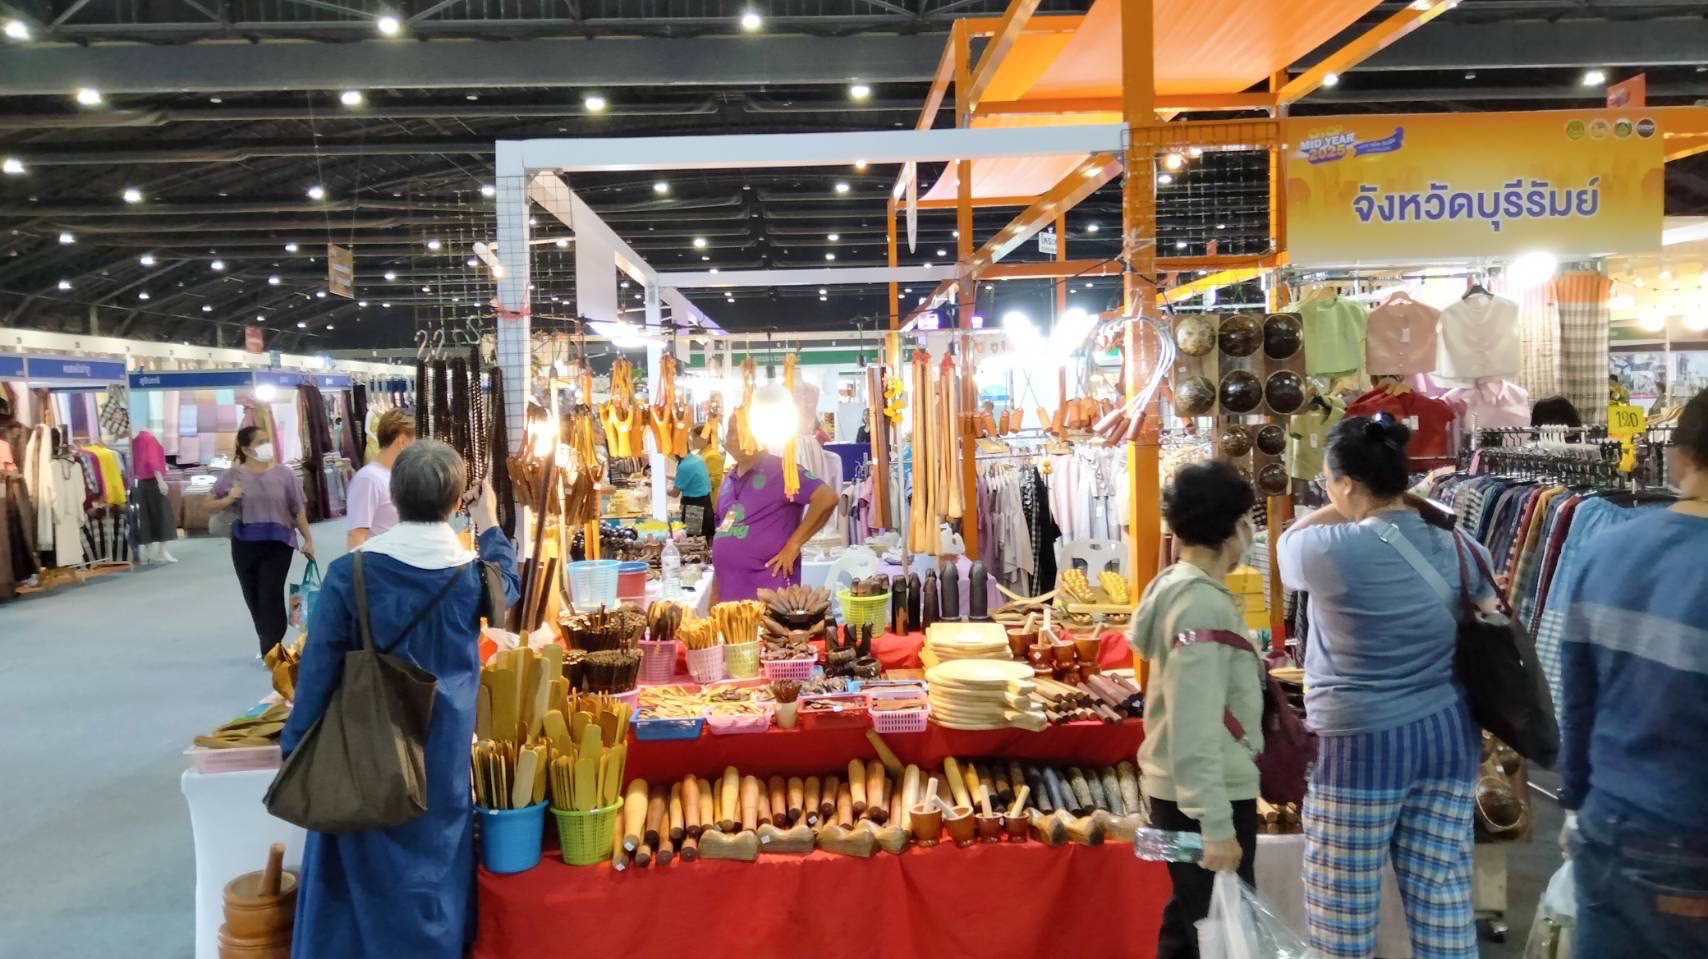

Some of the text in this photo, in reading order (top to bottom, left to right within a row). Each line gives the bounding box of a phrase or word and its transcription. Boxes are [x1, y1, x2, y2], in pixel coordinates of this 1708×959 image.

[1301, 138, 1323, 150] MID
[1324, 131, 1355, 148] YEAR
[1309, 143, 1346, 161] 2025
[1352, 176, 1601, 233] จังหวัดบุรีรัมย์
[1615, 410, 1639, 428] 120
